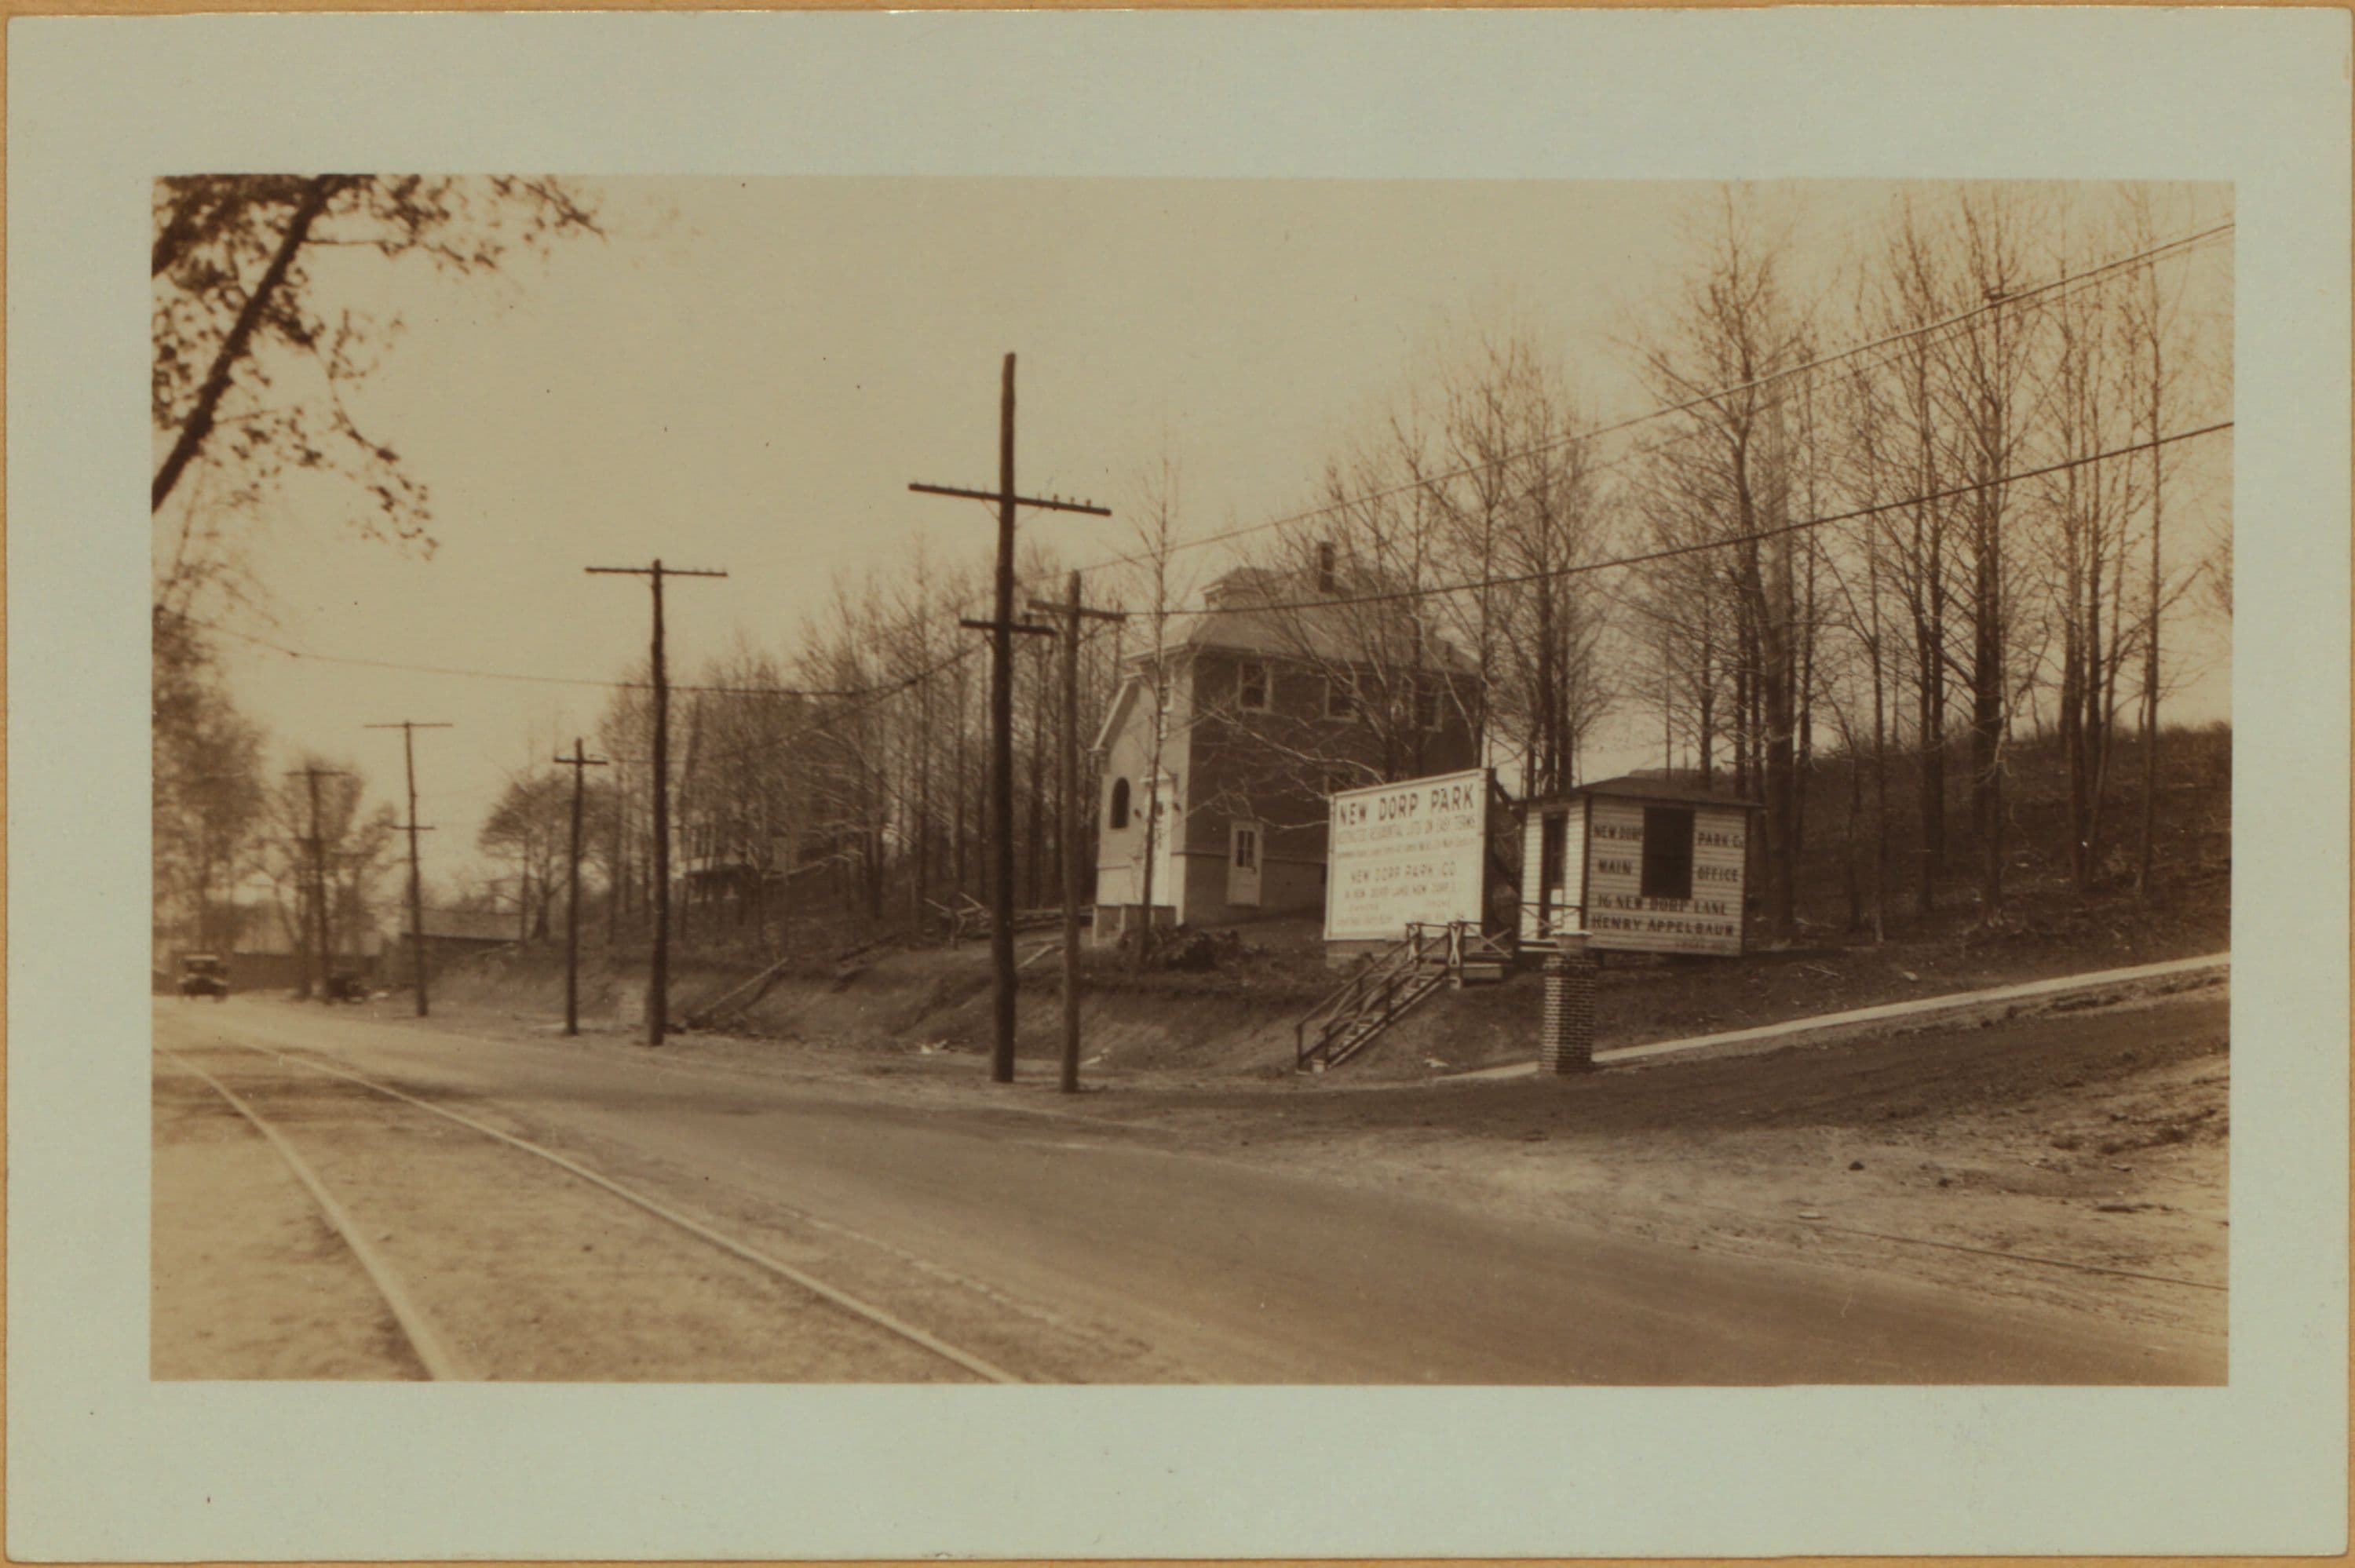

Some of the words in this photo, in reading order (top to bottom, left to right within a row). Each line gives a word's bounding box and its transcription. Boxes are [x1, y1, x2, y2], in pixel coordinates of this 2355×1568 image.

[1340, 802, 1368, 825] NEW
[1379, 793, 1418, 821] DORP
[1431, 785, 1473, 812] PARK
[1455, 815, 1476, 830] TERMS
[1594, 826, 1616, 840] NEW
[1698, 832, 1728, 848] PARK
[1351, 868, 1368, 884] NEW
[1375, 865, 1400, 882] DORP
[1406, 863, 1433, 877] PARK
[1598, 859, 1631, 875] MAIN
[1698, 866, 1738, 882] OFFICE
[1353, 888, 1366, 899] NEW
[1413, 883, 1427, 895] NEW
[1616, 895, 1643, 910] NEW
[1650, 898, 1689, 913] DORP
[1694, 900, 1727, 916] LANE
[1592, 916, 1641, 931] HENRY
[1648, 918, 1734, 936] APPELBAUM
